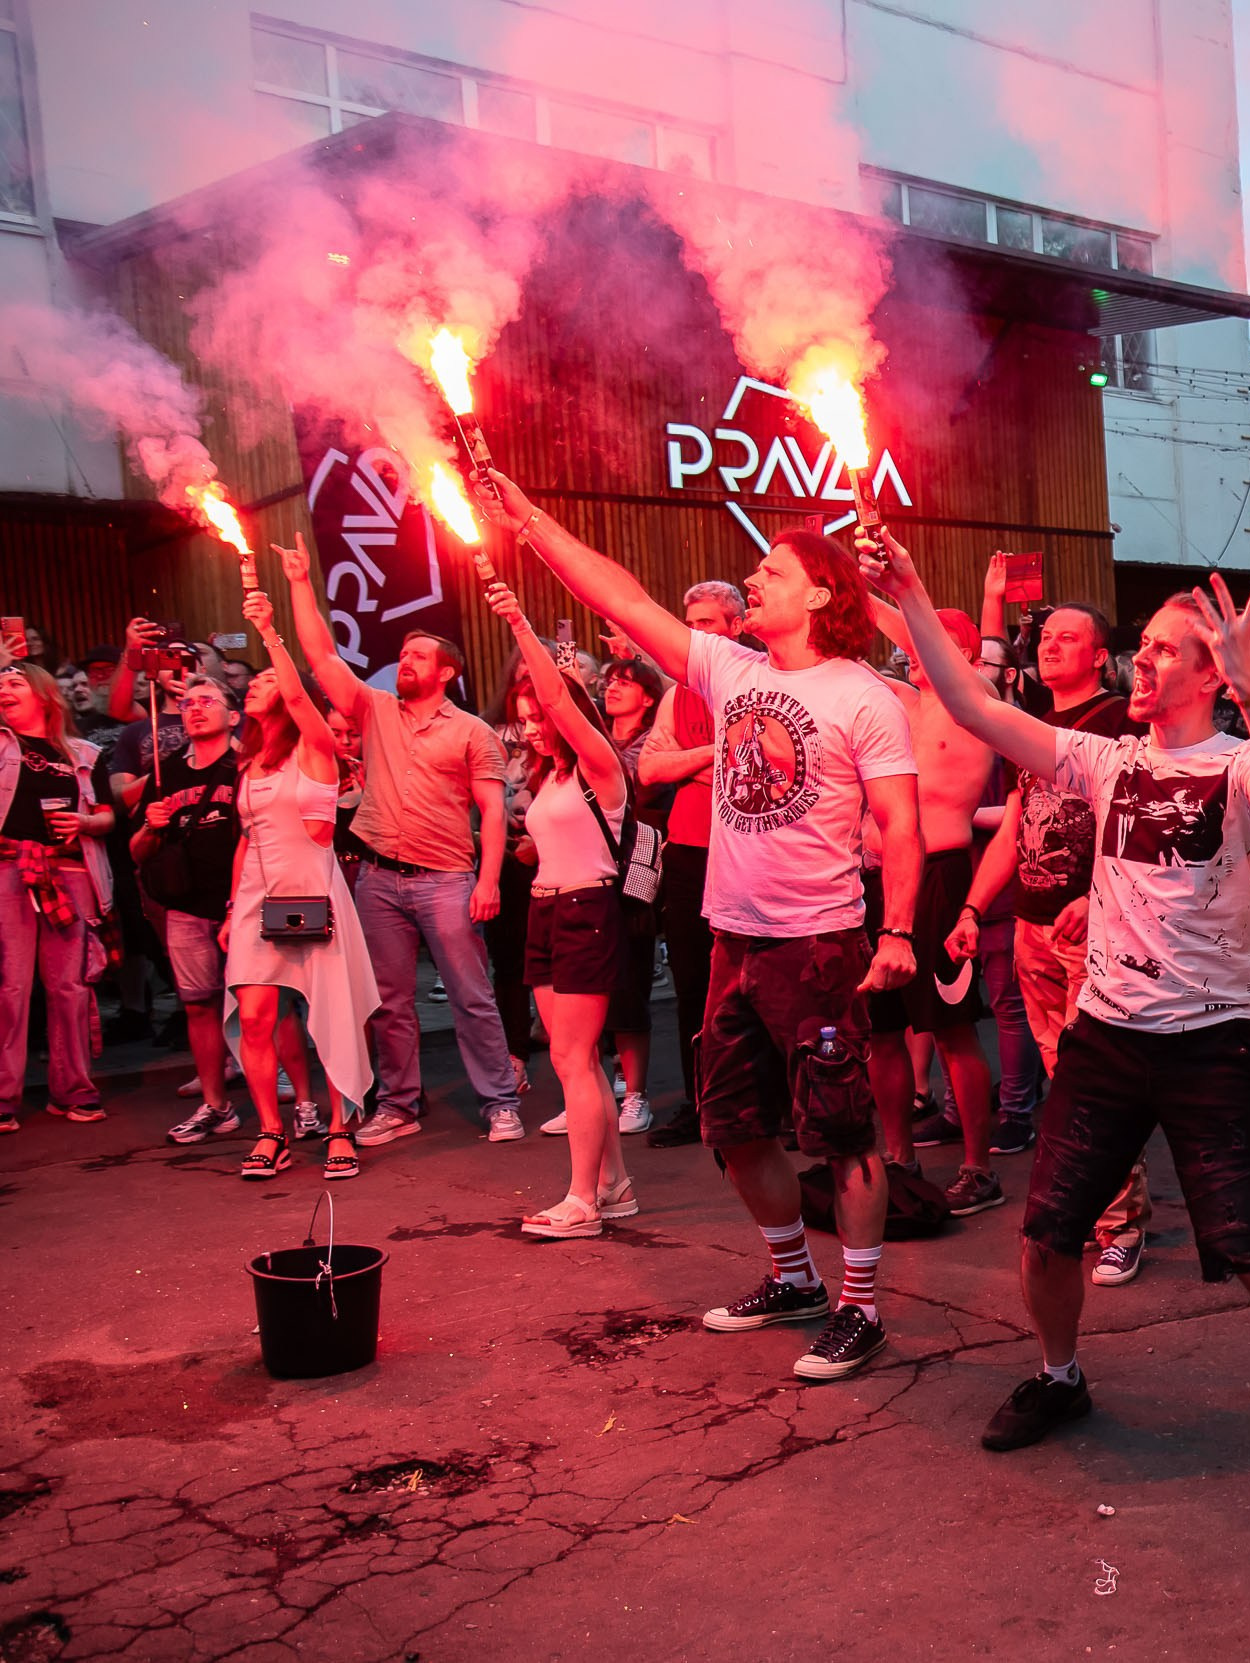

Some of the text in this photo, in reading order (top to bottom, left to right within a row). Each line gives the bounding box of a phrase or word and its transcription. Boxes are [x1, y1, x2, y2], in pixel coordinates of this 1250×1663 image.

[327, 446, 411, 669] PRAVD
[718, 801, 737, 825] YOU
[734, 813, 754, 833] GET
[754, 813, 783, 833] THE
[781, 789, 820, 825] BLUES
